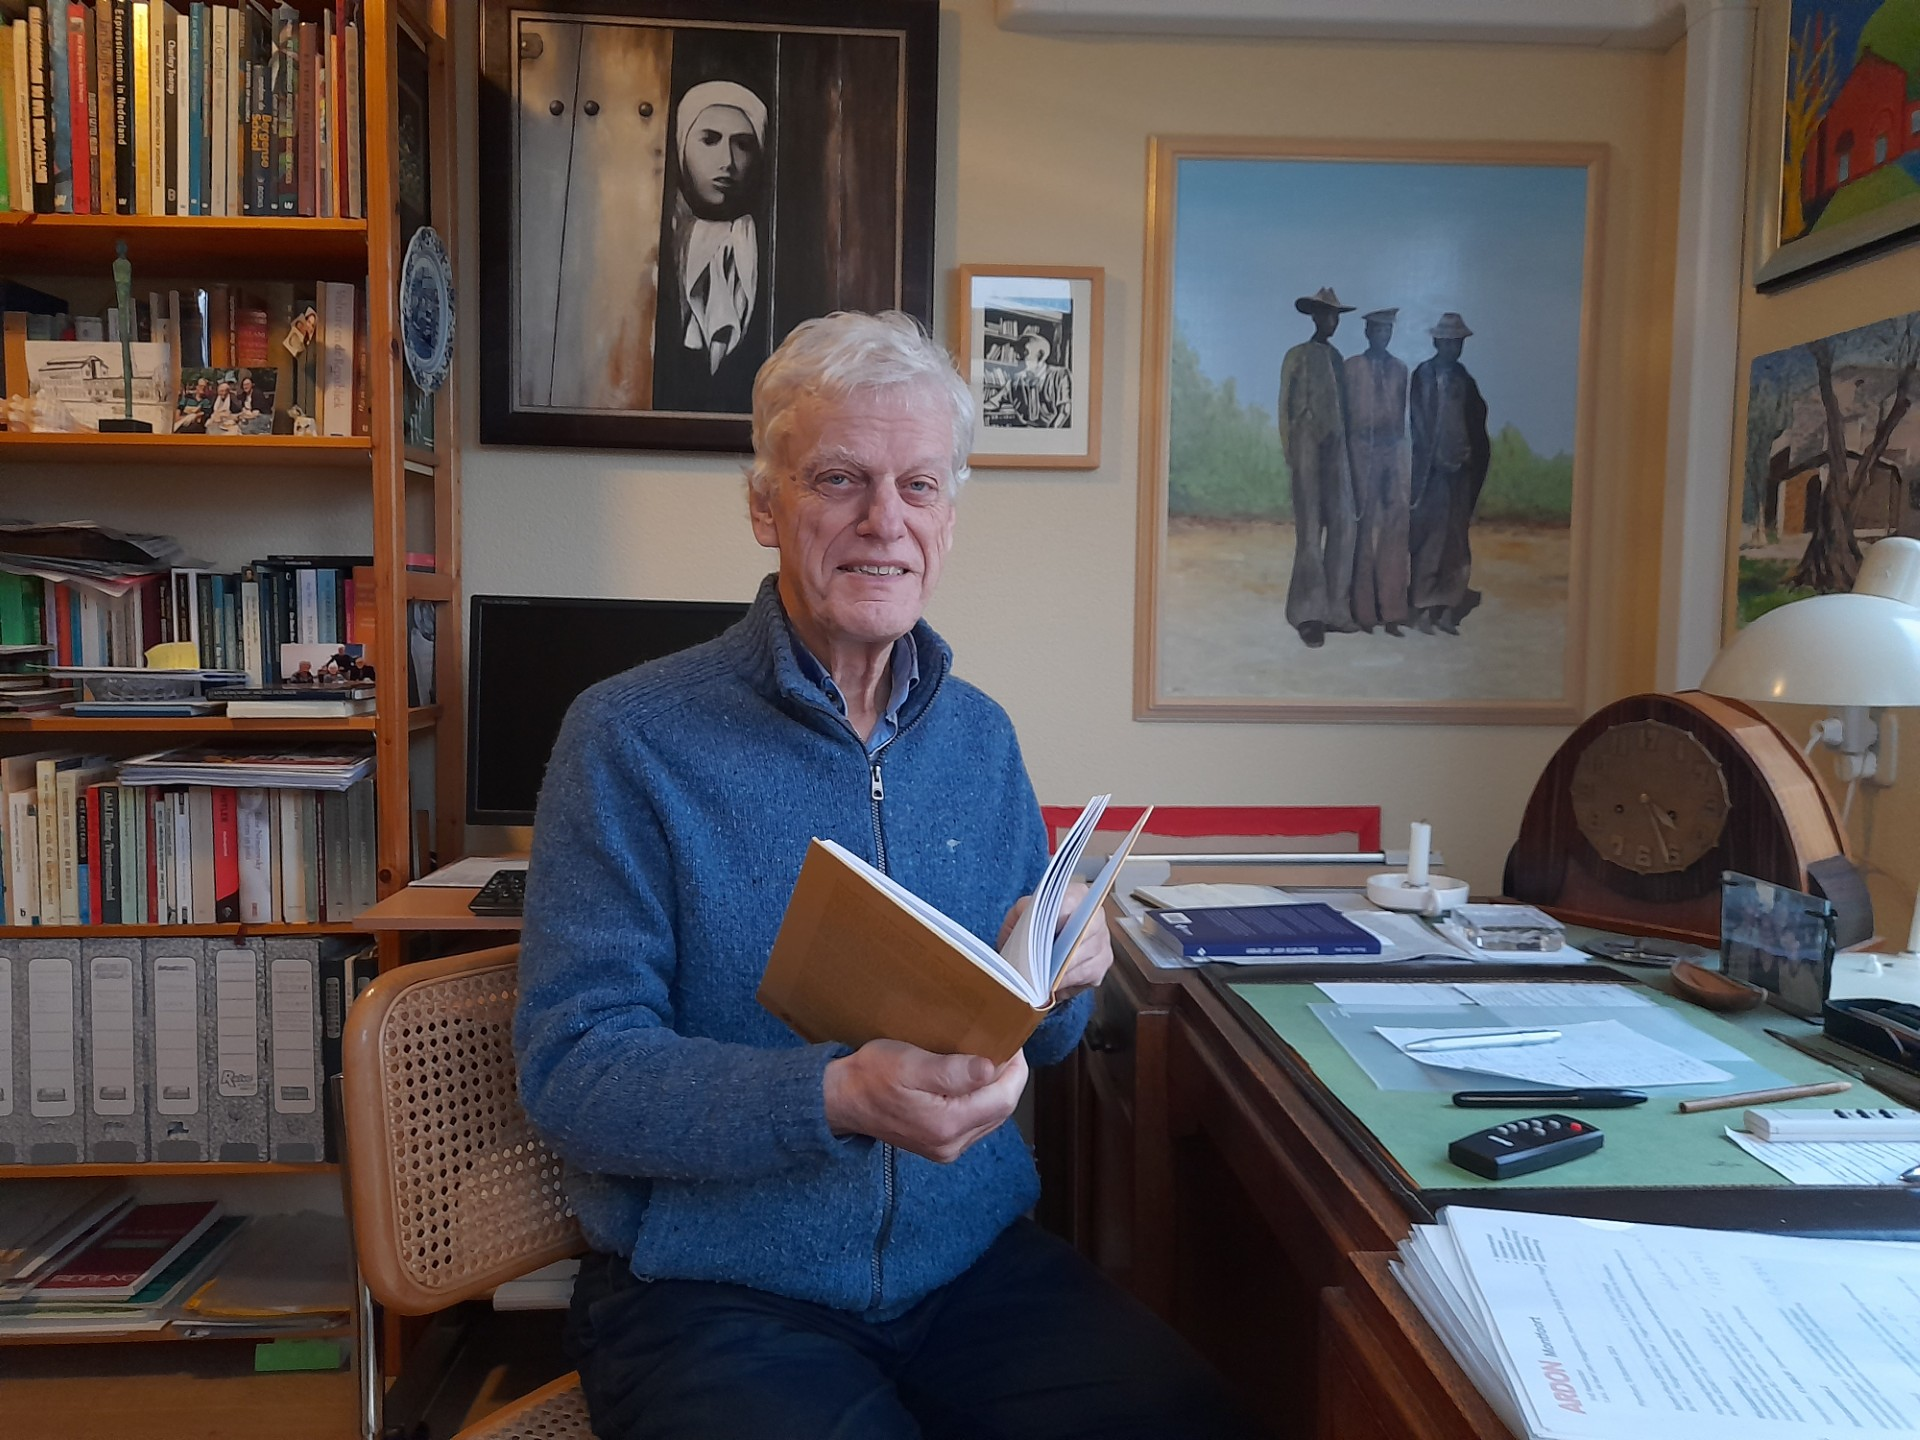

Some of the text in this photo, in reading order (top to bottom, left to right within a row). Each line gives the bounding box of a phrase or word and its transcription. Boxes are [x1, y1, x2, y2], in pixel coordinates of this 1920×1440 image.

[214, 24, 225, 44] Leo
[114, 9, 128, 146] Expressionisme in Nederland
[166, 40, 176, 95] Charley Toorop
[214, 46, 225, 79] Gestel
[252, 114, 262, 151] School
[259, 115, 272, 168] Bergense
[333, 290, 346, 408] Voltaire en de Republiek
[219, 794, 229, 823] HITLER
[1527, 1316, 1559, 1358] Montfoort
[1537, 1359, 1588, 1416] ARDON
